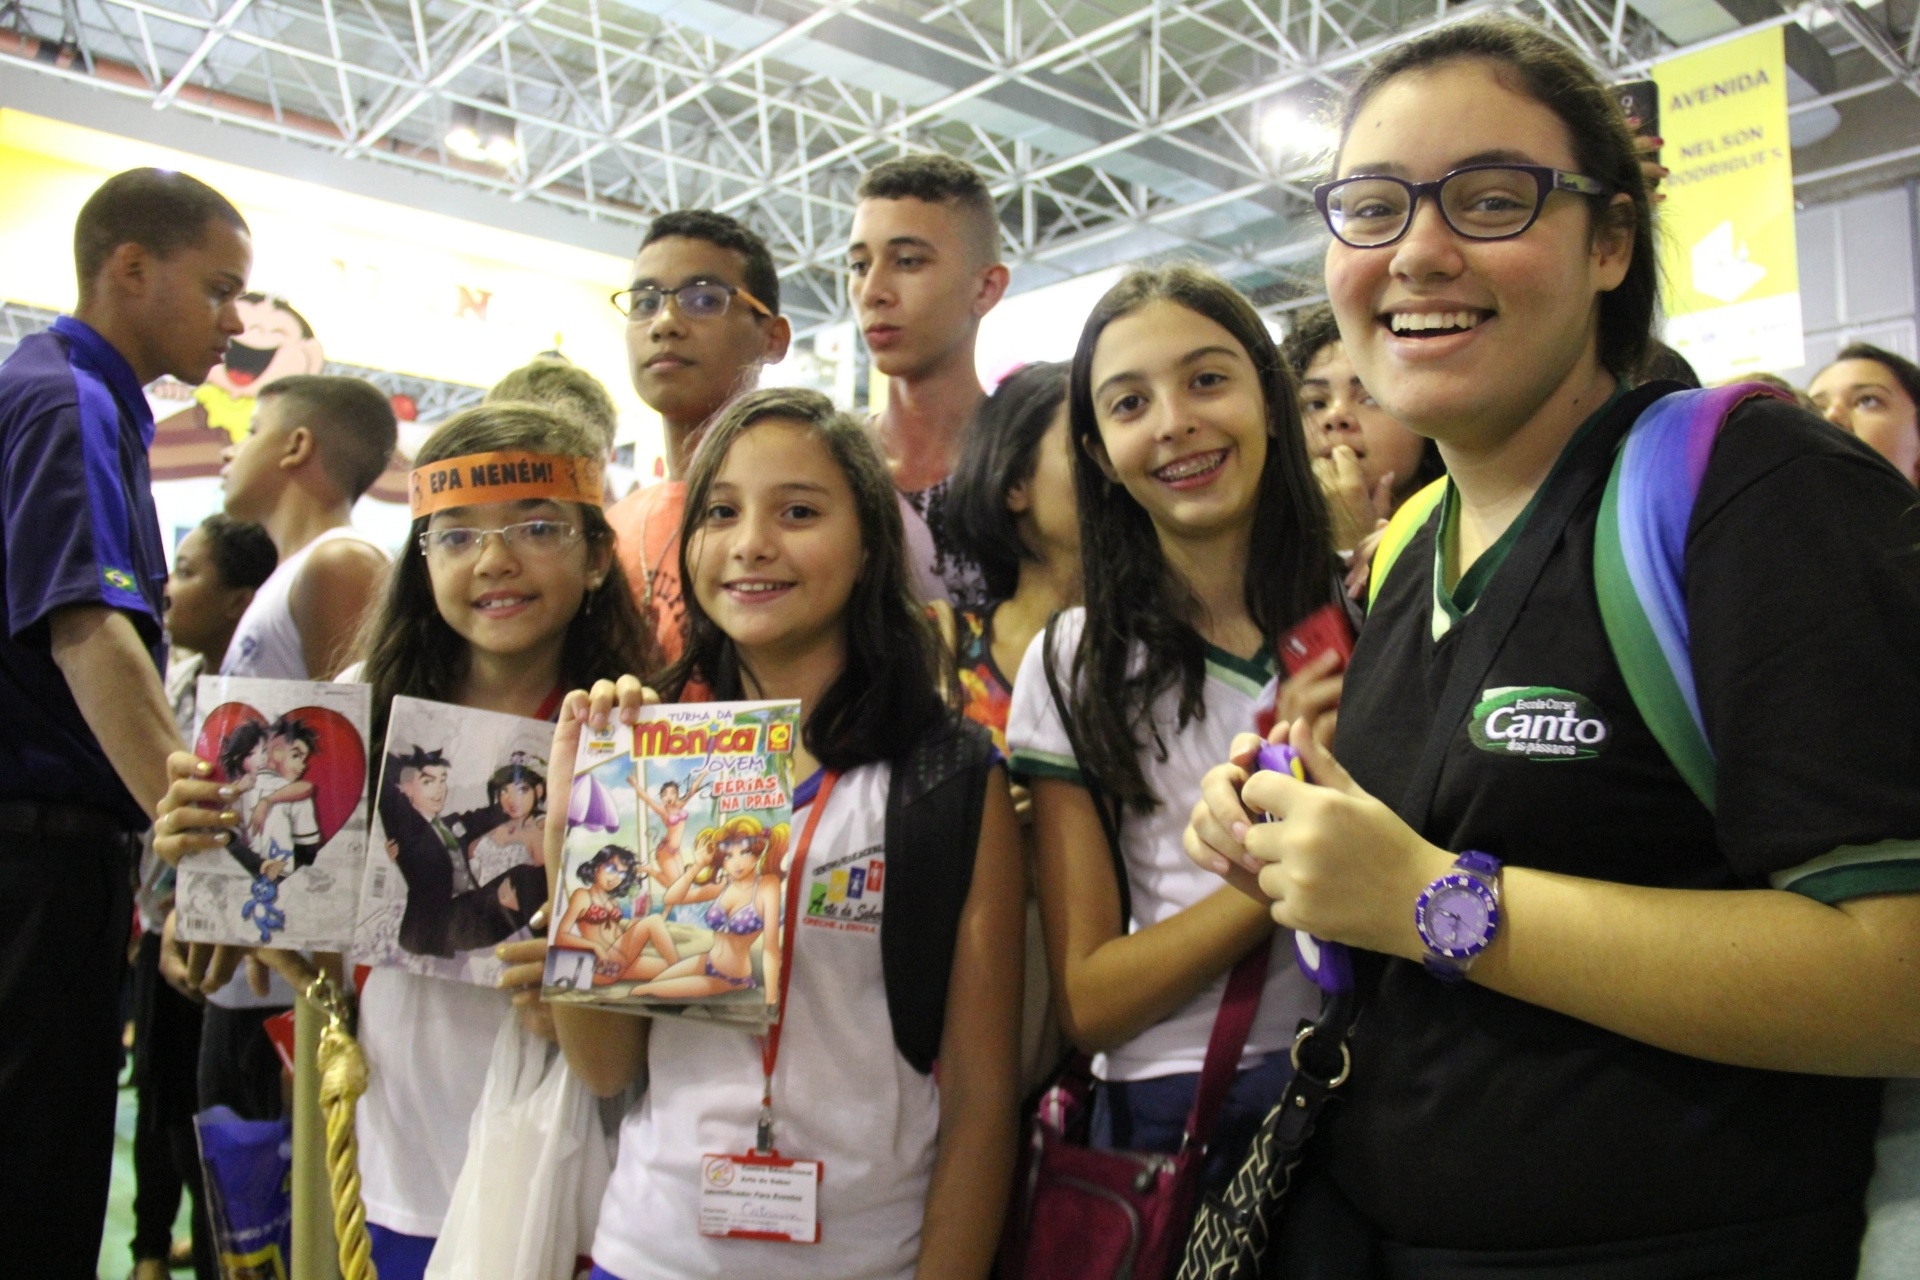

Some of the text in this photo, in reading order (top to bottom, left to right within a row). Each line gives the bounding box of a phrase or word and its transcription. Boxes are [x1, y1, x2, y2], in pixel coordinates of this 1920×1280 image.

[1670, 69, 1770, 112] AVENIDA
[1680, 126, 1763, 159] NELSON
[429, 458, 553, 494] EPA NENÉM!
[668, 709, 732, 722] TURMA DA
[1485, 707, 1606, 744] Canto
[633, 720, 758, 758] Mônica
[720, 798, 740, 812] NA
